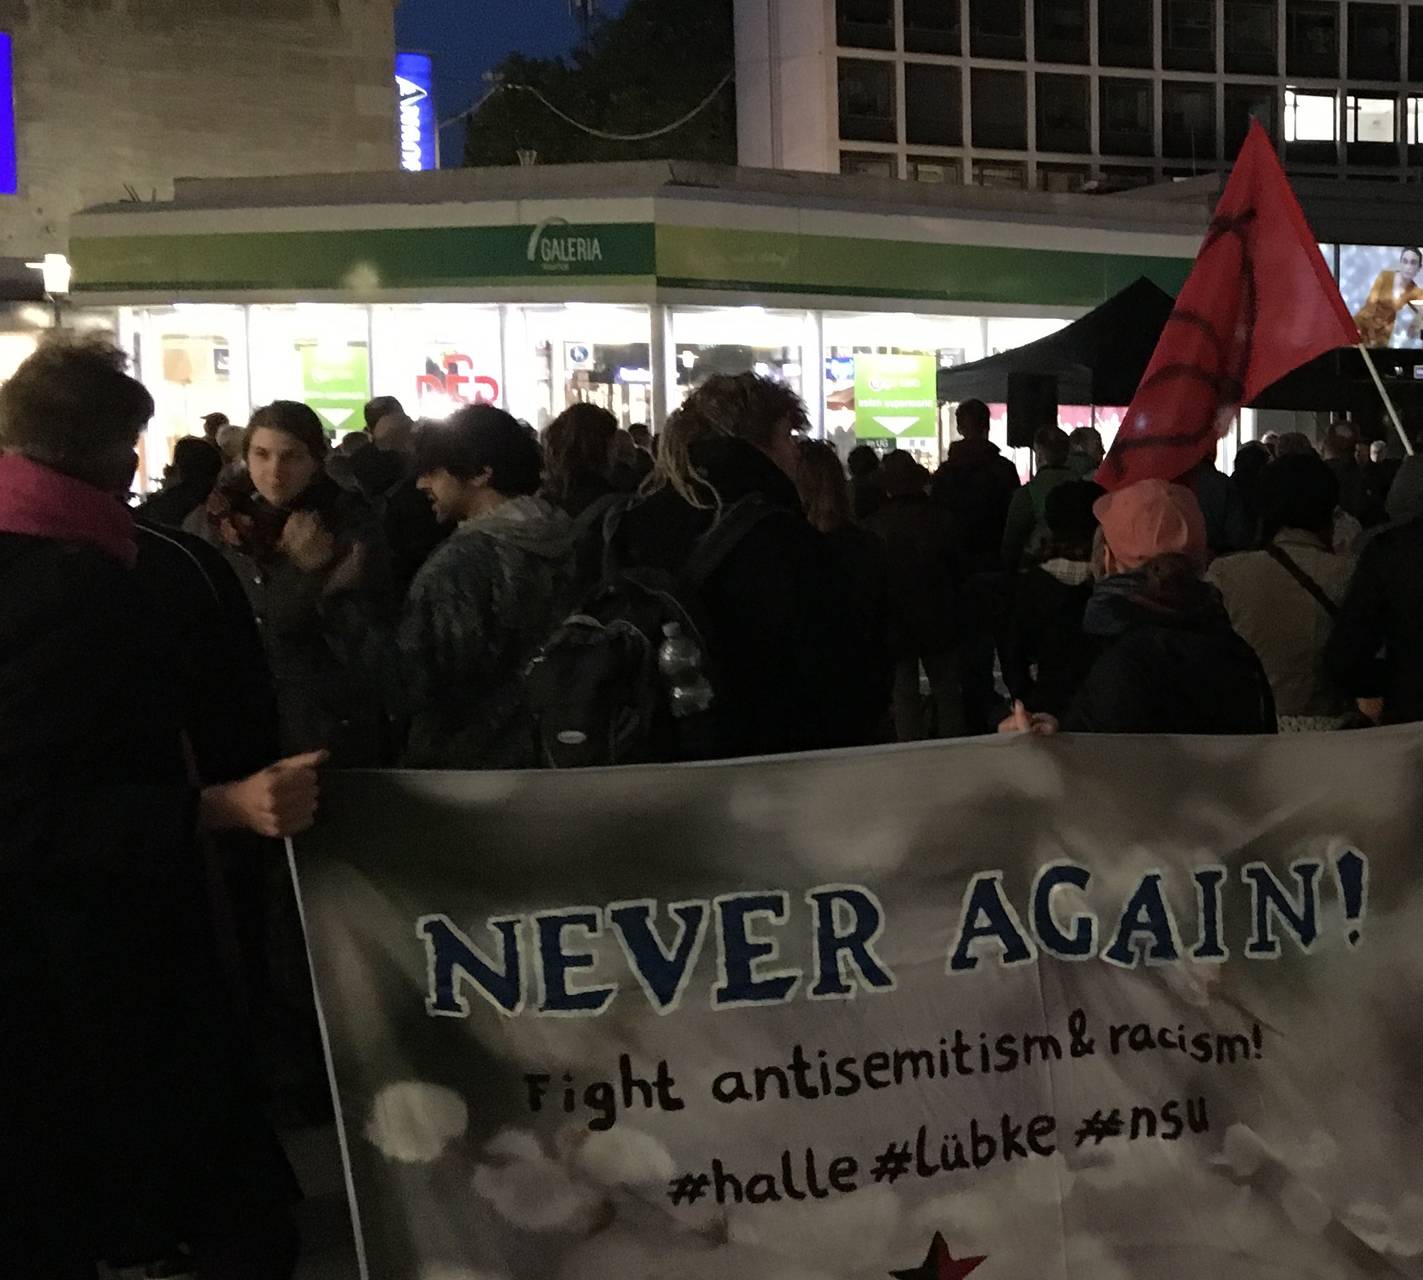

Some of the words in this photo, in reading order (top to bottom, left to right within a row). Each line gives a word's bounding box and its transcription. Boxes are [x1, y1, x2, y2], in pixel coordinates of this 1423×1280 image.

[540, 237, 603, 262] GALERIA
[417, 883, 893, 1018] NEVER
[945, 846, 1370, 976] AGAIN!
[523, 1053, 685, 1131] Fight
[1109, 1023, 1263, 1064] racism!
[667, 1147, 858, 1205] #halle
[870, 1112, 1057, 1184] #lübke
[1075, 1096, 1209, 1147] #nsu
